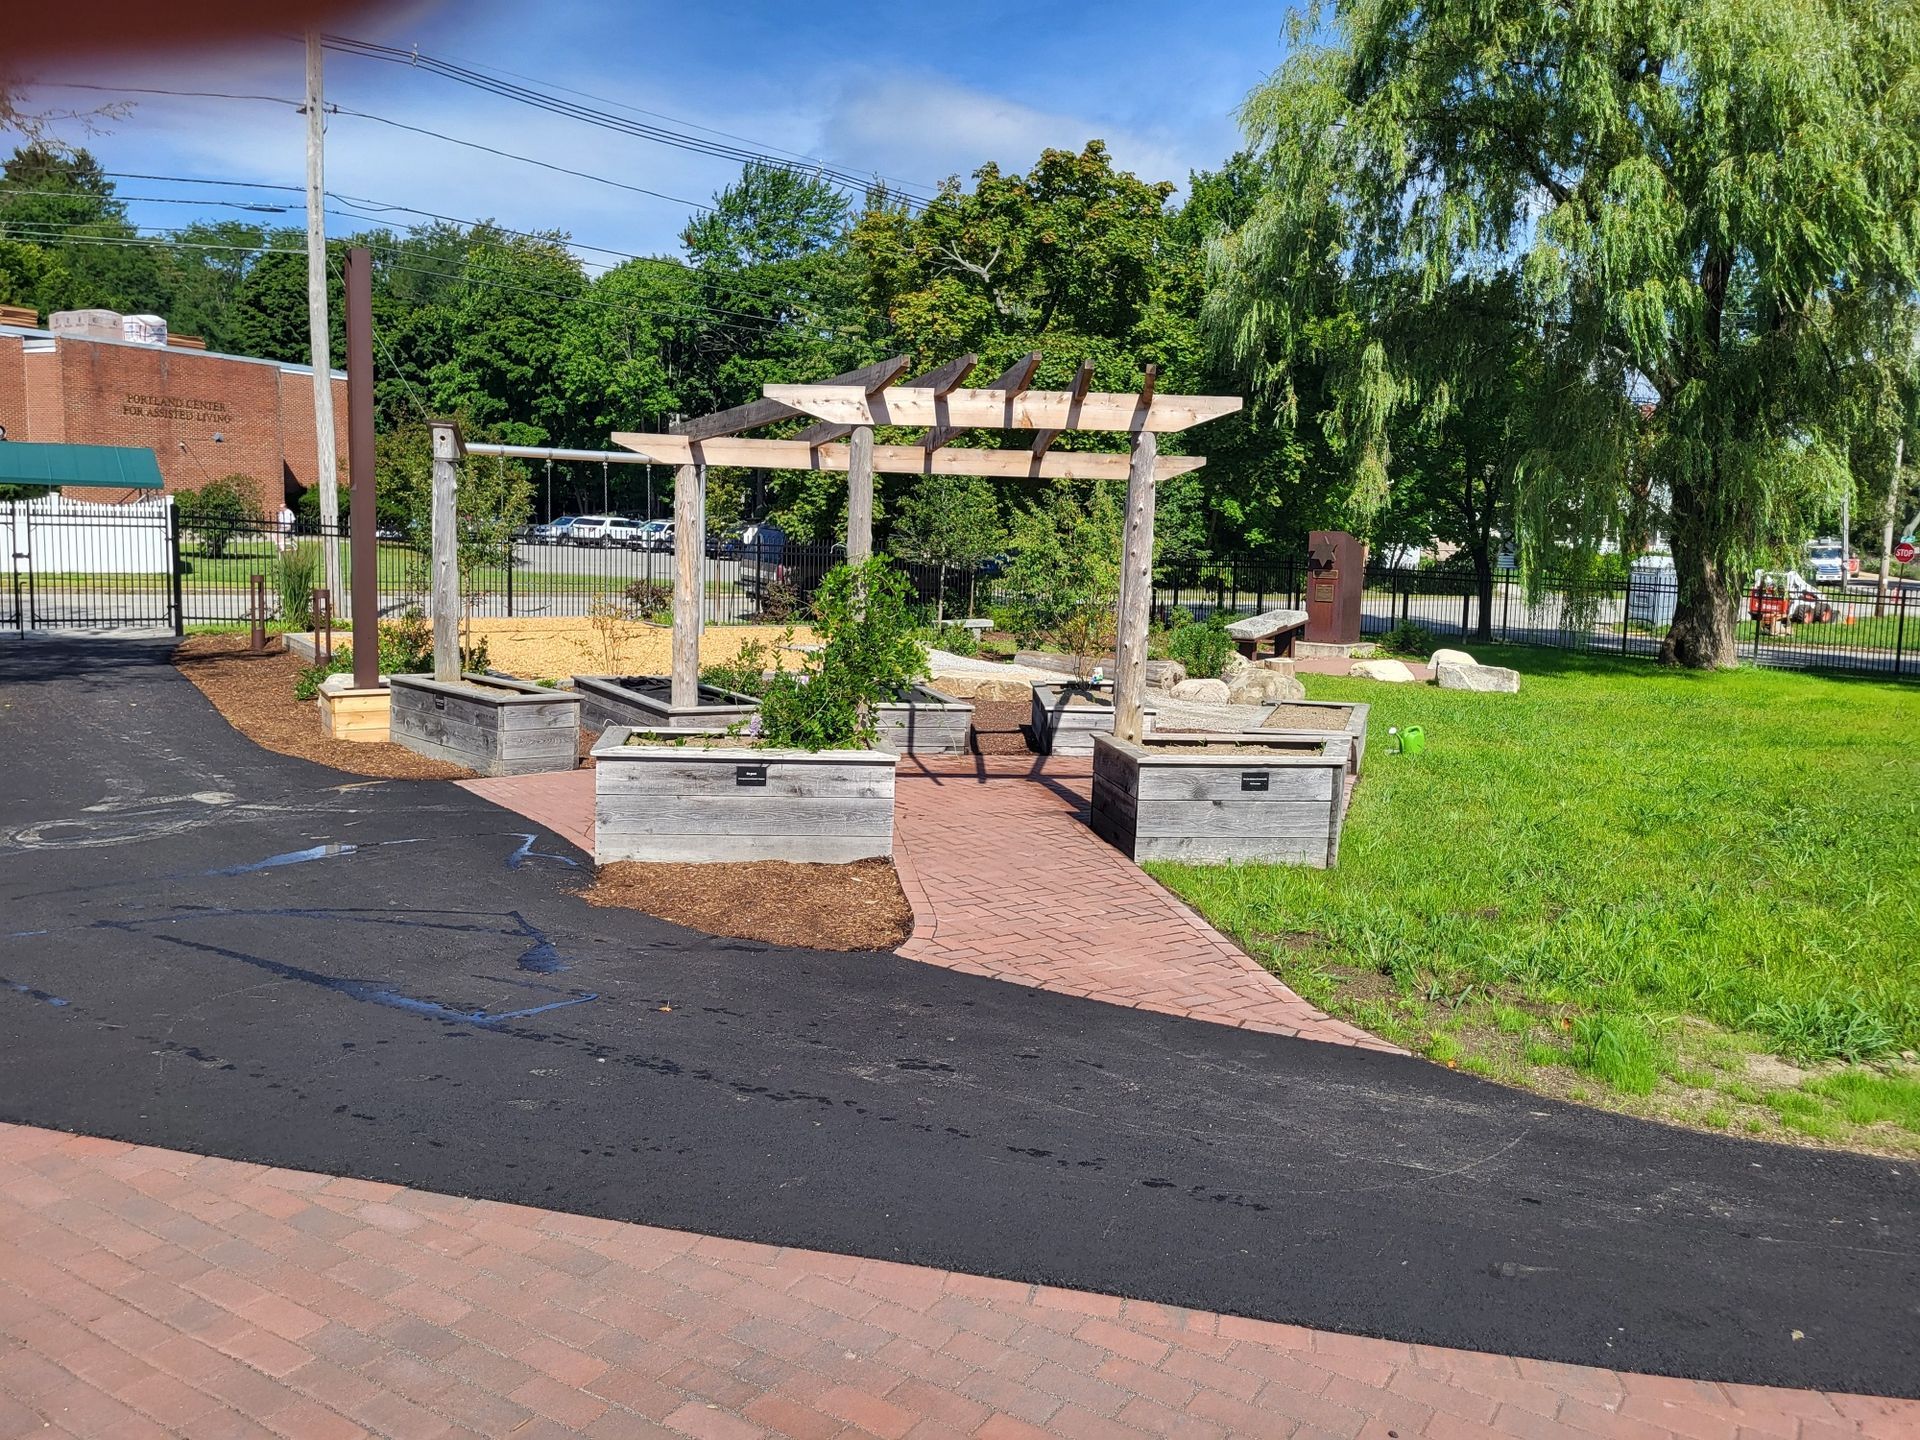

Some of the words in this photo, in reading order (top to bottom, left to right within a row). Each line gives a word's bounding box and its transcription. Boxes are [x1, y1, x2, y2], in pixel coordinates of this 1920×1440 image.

[127, 394, 184, 407] PORTLAND
[186, 400, 226, 412] CENTER
[123, 405, 144, 416] FOR
[147, 408, 194, 420] ASSISTED
[197, 413, 232, 424] LIVING
[1895, 549, 1914, 557] STOP
